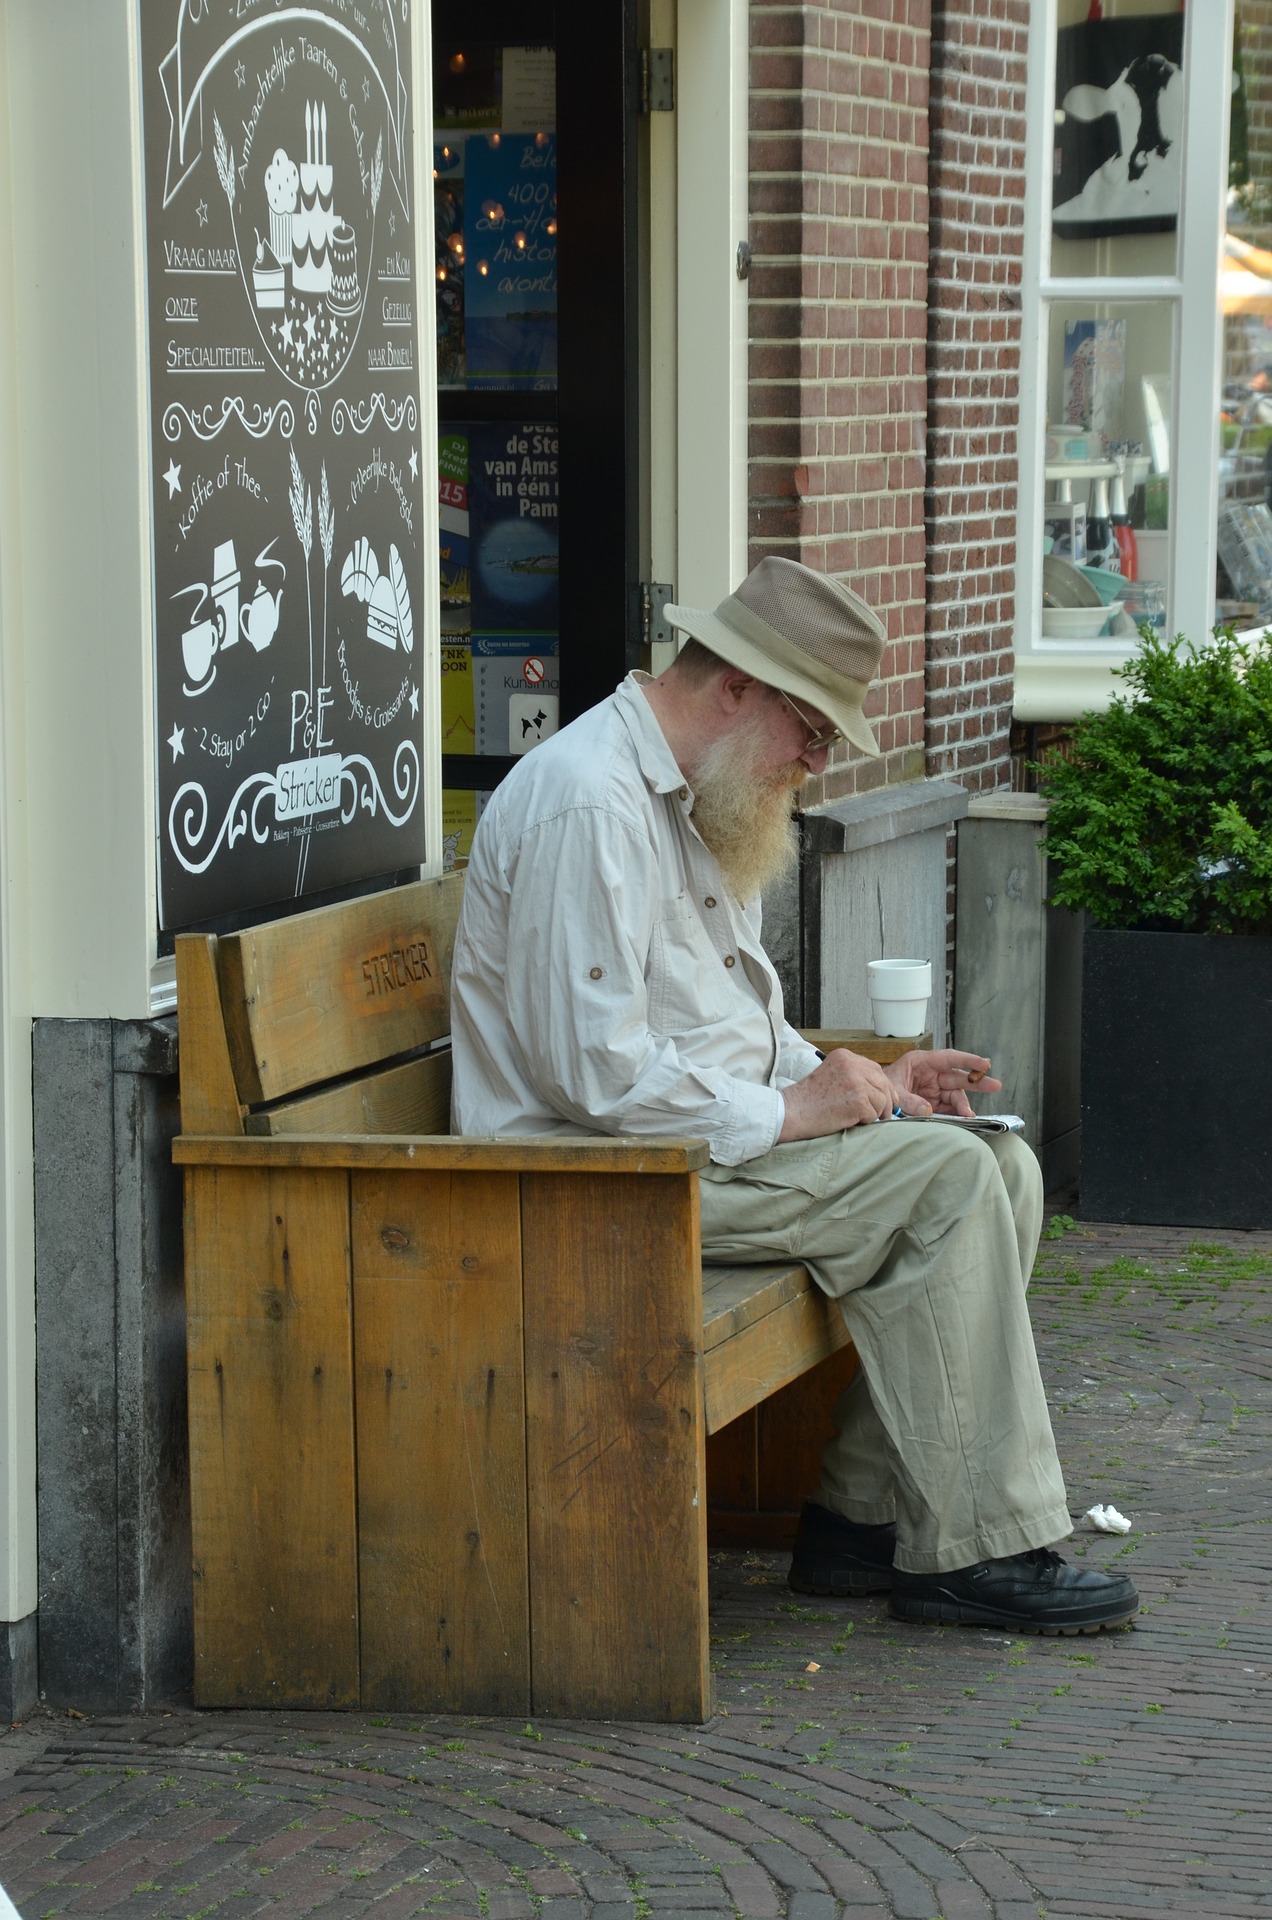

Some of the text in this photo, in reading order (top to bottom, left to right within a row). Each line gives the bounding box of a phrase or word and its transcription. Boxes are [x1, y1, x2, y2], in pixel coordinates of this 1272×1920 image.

[237, 36, 370, 196] Ambachtelijke Taarten & Gebak
[507, 183, 550, 204] 400
[165, 297, 199, 317] ONZE
[452, 441, 465, 453] DJ
[506, 434, 529, 454] de
[442, 450, 468, 466] Fred
[484, 455, 558, 475] van Ams
[178, 453, 261, 540] Koffie of Thee
[496, 477, 513, 496] in
[517, 476, 550, 496] één
[388, 460, 413, 535] Belegde
[519, 497, 558, 517] Pam
[337, 638, 410, 729] Broodjes & Croissants
[199, 727, 208, 751] 2
[209, 733, 233, 769] Stay
[235, 729, 247, 751] or
[248, 715, 257, 738] 2
[277, 764, 340, 814] Stricker
[362, 942, 432, 997] STRICKER
